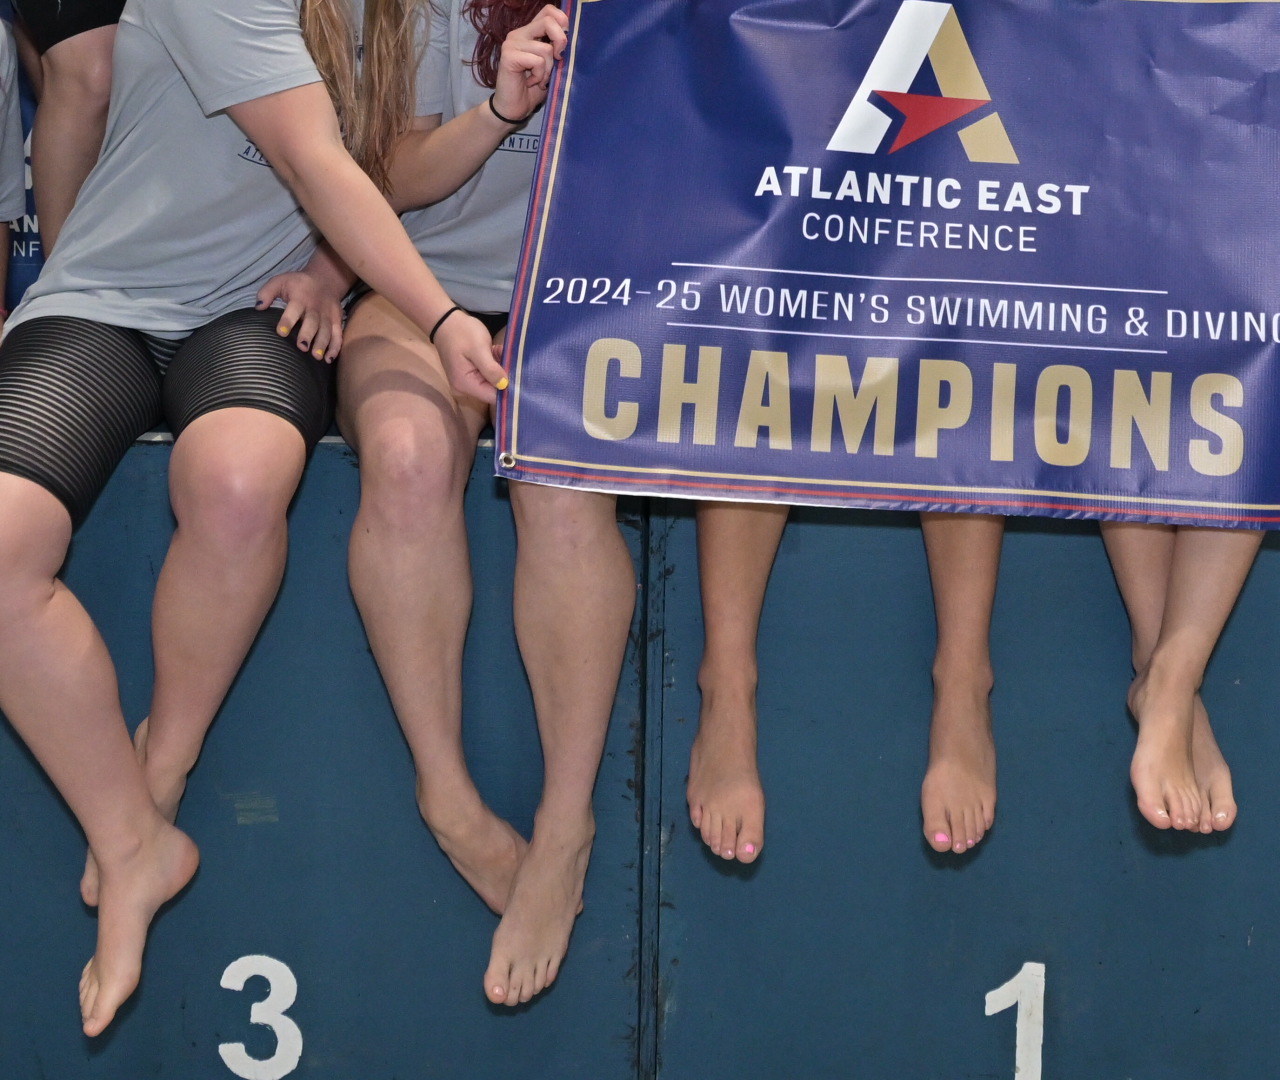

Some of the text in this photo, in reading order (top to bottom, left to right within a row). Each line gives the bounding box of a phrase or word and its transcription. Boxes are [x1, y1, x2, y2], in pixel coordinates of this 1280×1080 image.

[755, 166, 1090, 215] ATLANTIC EAST
[803, 213, 1036, 252] CONFERENCE
[543, 278, 704, 310] 2024-25
[720, 284, 888, 323] WOMEN'S
[907, 296, 1106, 334] SWIMMING
[1125, 307, 1148, 336] &
[581, 335, 1246, 480] CHAMPIONS
[219, 955, 303, 1080] 3
[985, 962, 1045, 1080] 1
